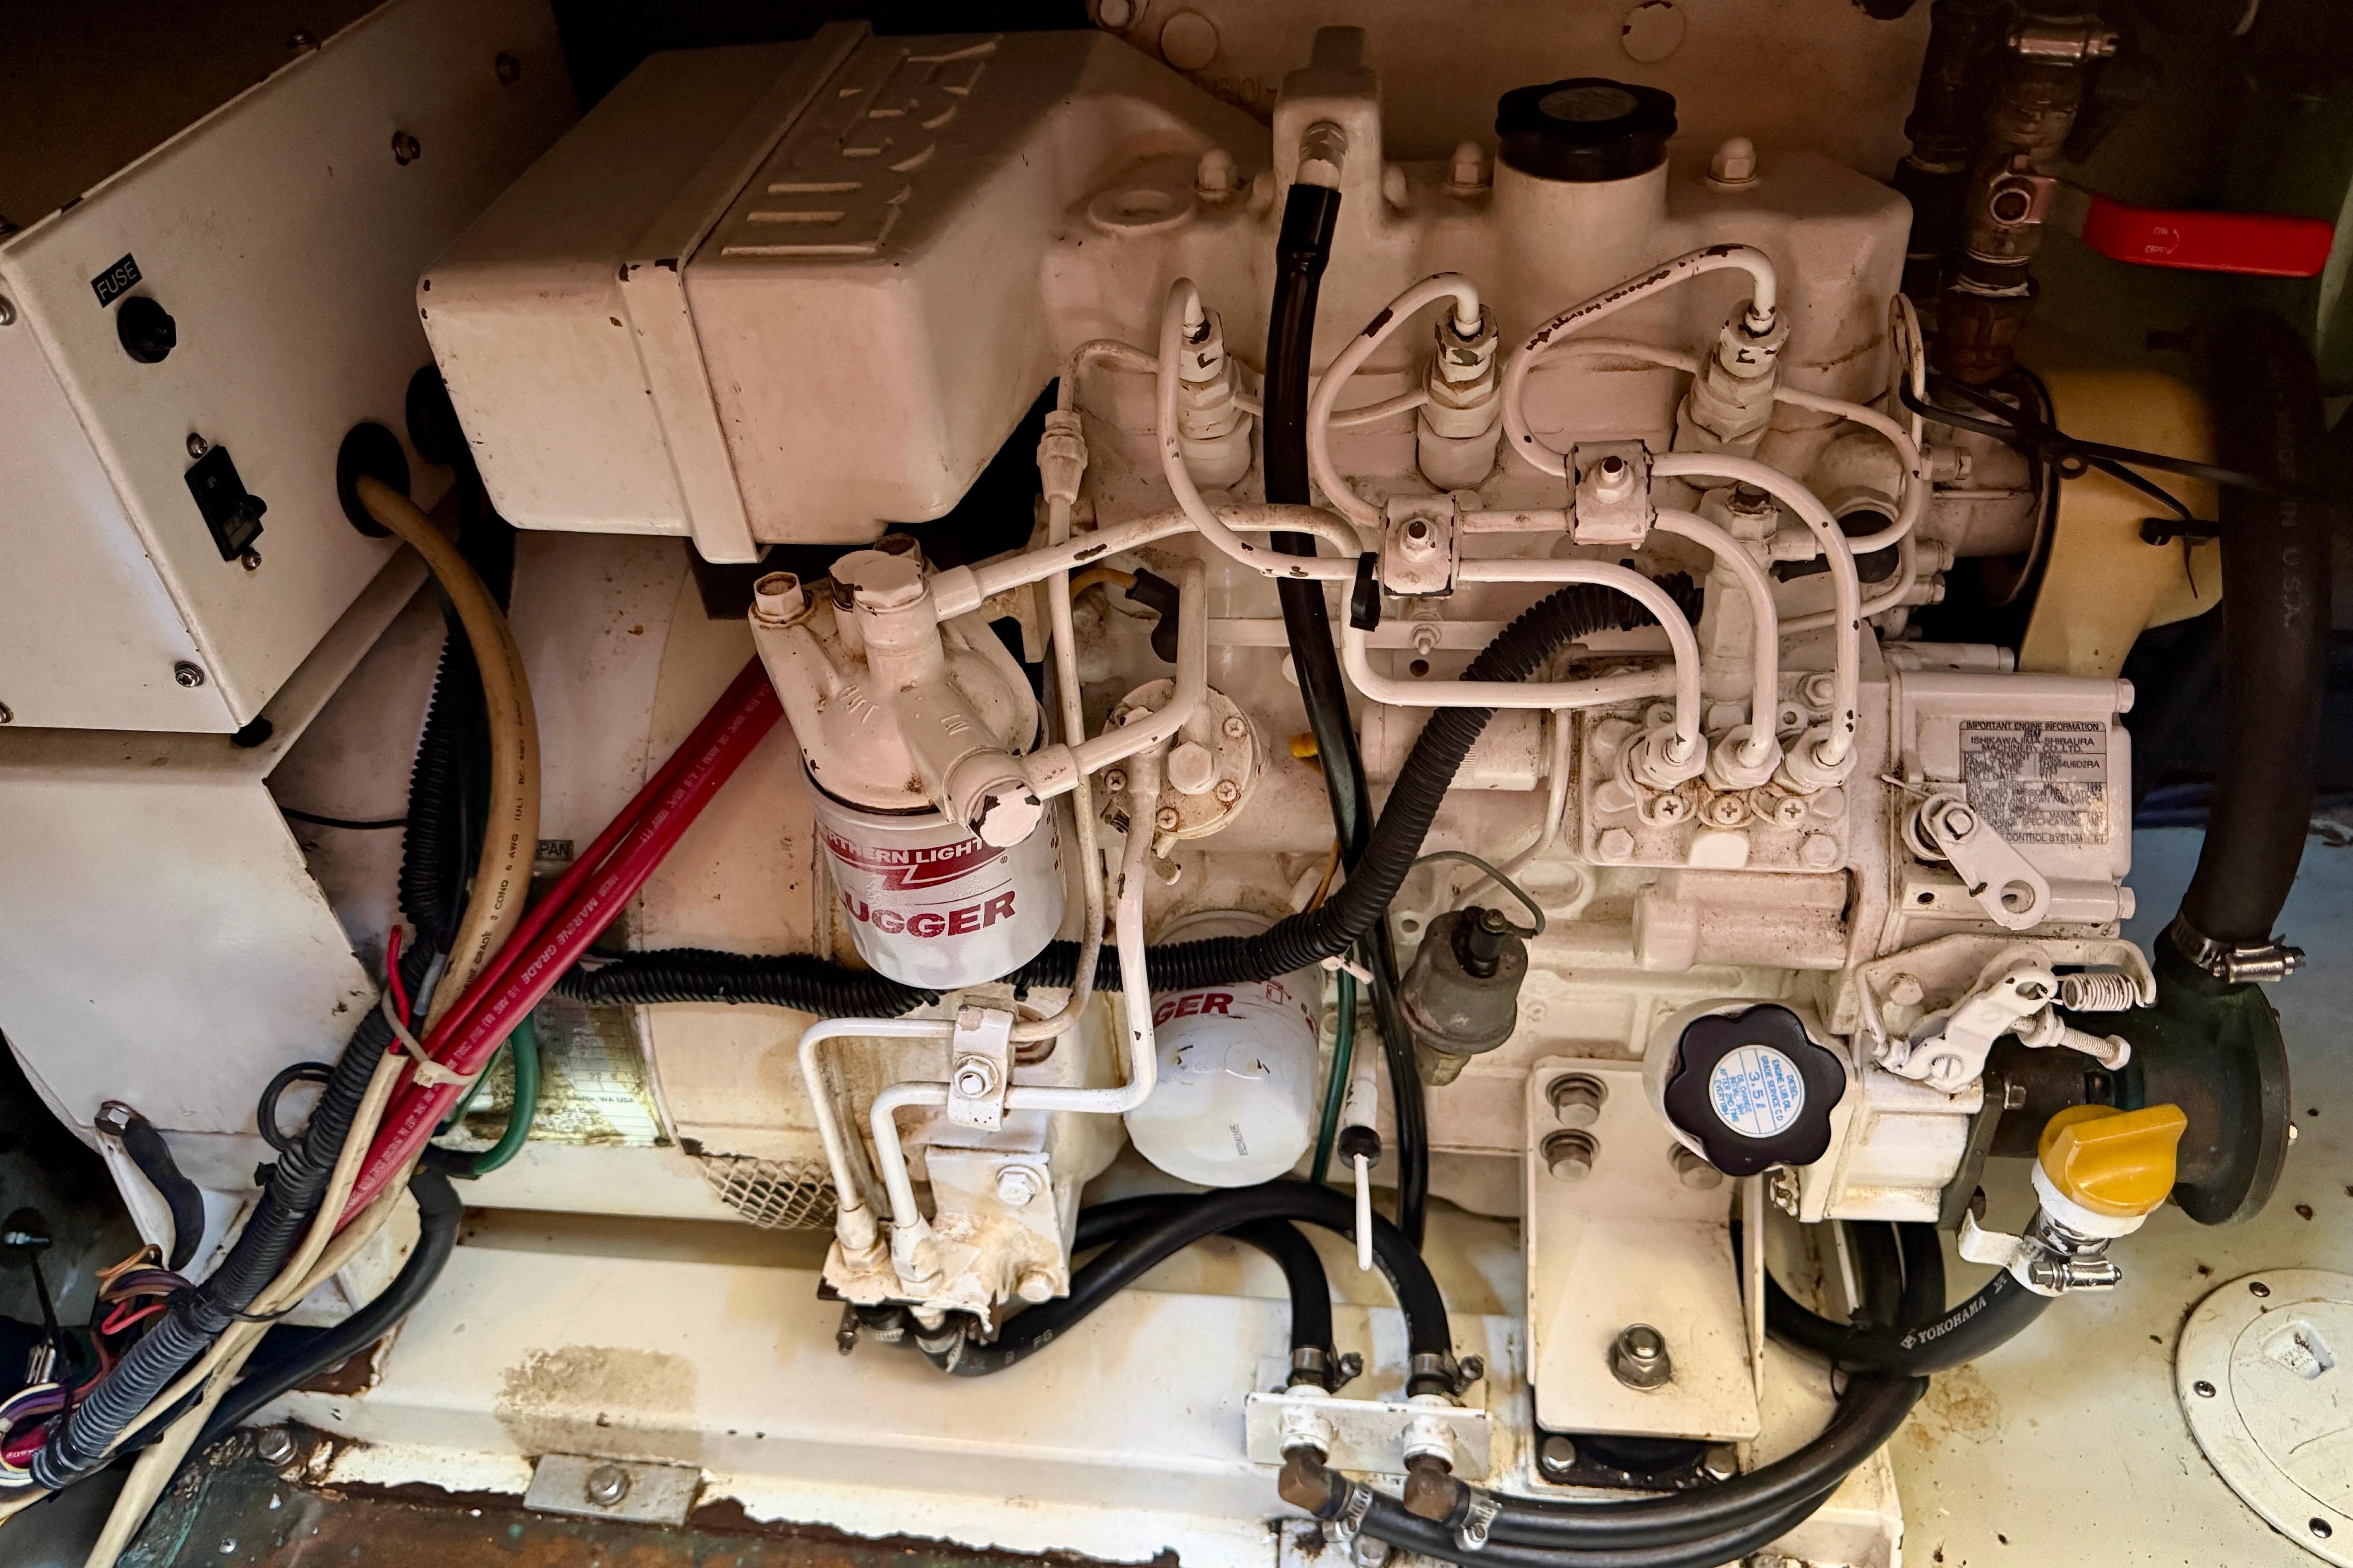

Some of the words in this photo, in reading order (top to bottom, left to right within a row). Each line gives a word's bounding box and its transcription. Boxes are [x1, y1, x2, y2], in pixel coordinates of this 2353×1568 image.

[97, 262, 137, 300] FUSE
[2045, 722, 2098, 731] INFORMATION
[535, 843, 570, 857] PAN
[916, 839, 982, 864] LIGHT
[2007, 833, 2046, 842] CONTROL
[2049, 834, 2082, 842] SYSTEM
[494, 880, 509, 910] COND
[510, 833, 519, 859] AWG
[557, 898, 598, 946] MARINE
[844, 890, 1016, 938] UGGER
[521, 944, 557, 985] GRADE
[1153, 993, 1233, 1028] GER
[1719, 1068, 1730, 1090] AFTER
[1761, 1055, 1772, 1078] GRADE
[1767, 1079, 1780, 1108] SERVICE
[1772, 1059, 1784, 1084] ENGINE
[1739, 1086, 1752, 1112] CHANGE
[1787, 1075, 1798, 1099] DIESEL
[1918, 1296, 1987, 1344] YOKOHAMA
